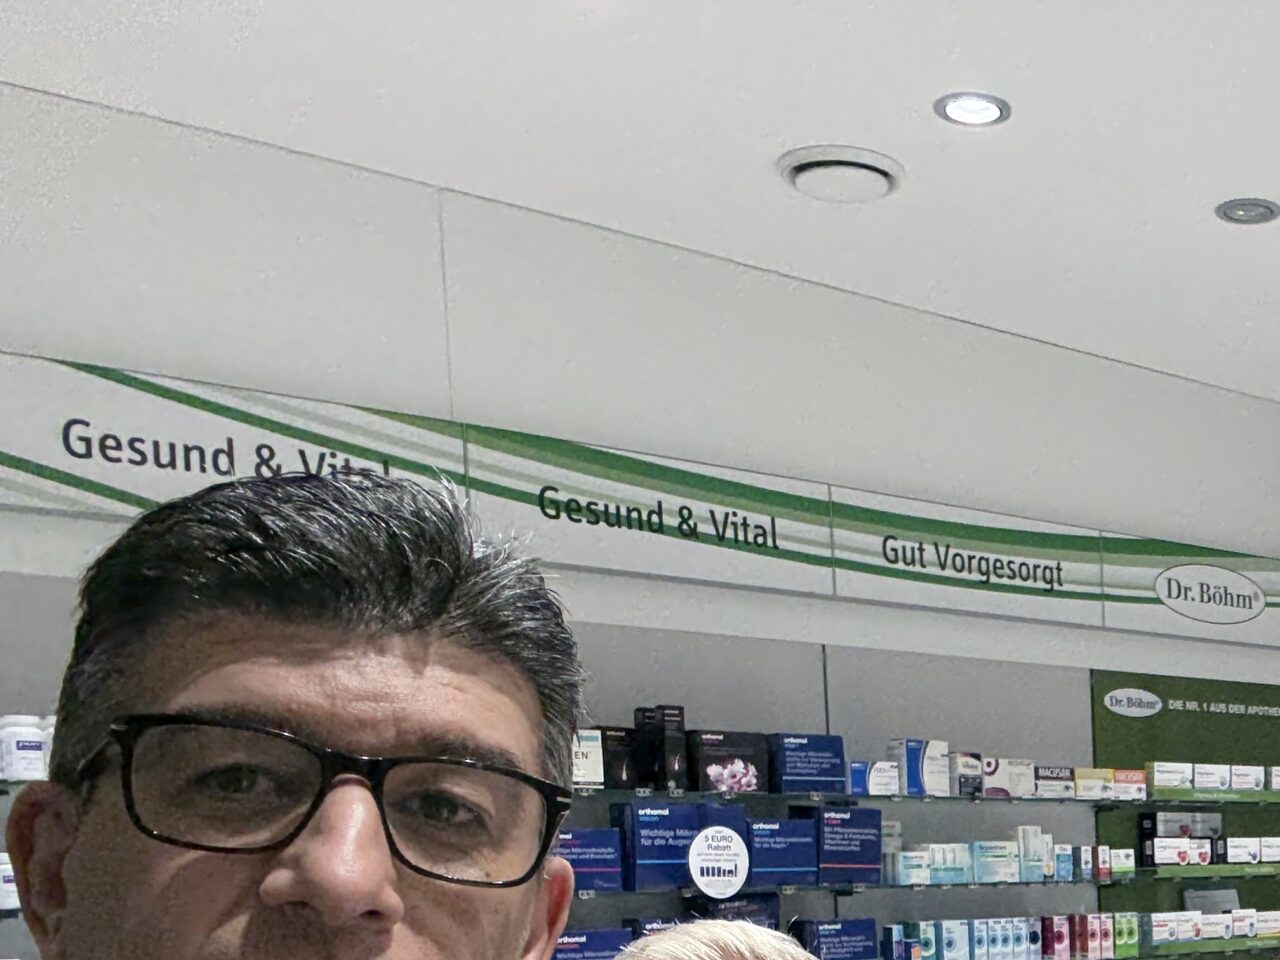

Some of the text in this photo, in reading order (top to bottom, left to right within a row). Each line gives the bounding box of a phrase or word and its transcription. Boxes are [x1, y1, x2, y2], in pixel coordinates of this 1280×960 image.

[62, 418, 235, 477] Gesund
[254, 443, 282, 480] &
[538, 485, 780, 550] Gesund & Vital
[881, 534, 1064, 592] Gut Vorgesorgt
[1165, 577, 1195, 602] Dr.
[1168, 699, 1183, 711] DIE
[1209, 702, 1227, 713] AUS
[1228, 703, 1246, 715] DER
[704, 835, 733, 843] 5 EURO
